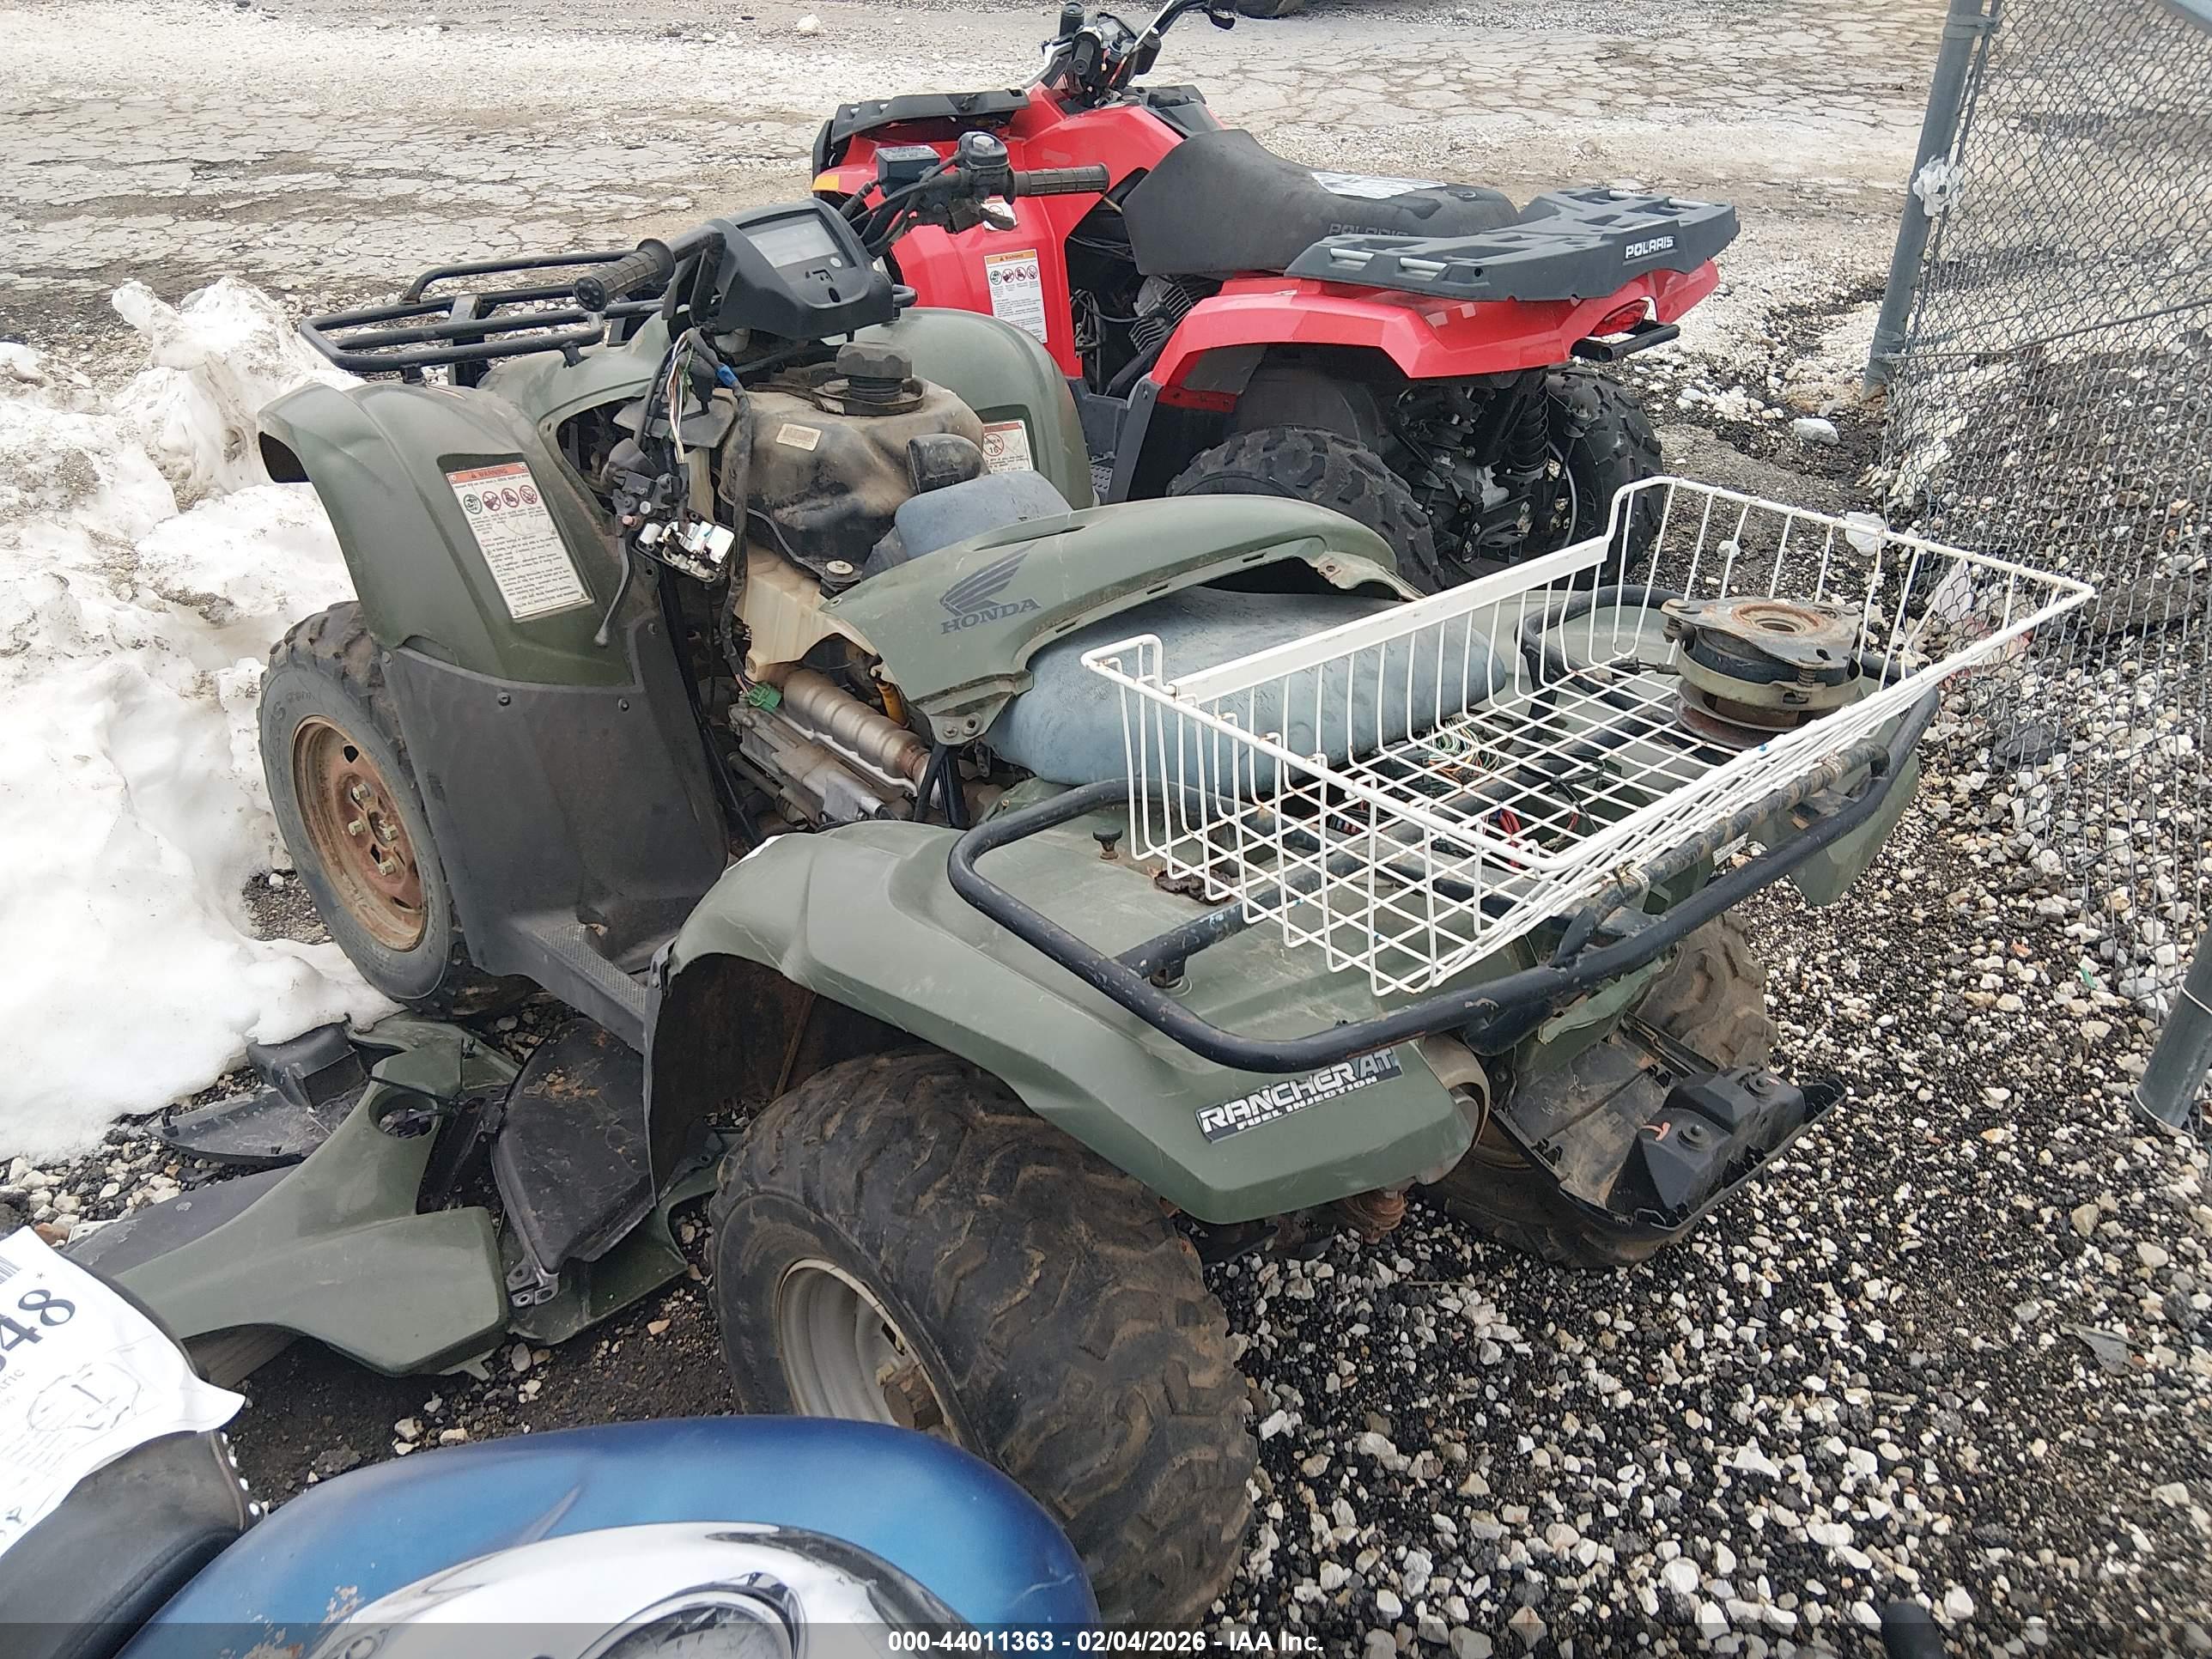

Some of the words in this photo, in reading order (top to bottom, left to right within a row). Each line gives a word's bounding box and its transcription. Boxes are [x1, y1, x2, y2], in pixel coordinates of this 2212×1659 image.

[1626, 236, 1674, 258] POLARIS
[941, 598, 1042, 635] HONDA
[1200, 1061, 1357, 1133] RANCHER
[1359, 1047, 1395, 1079] AT
[1237, 1107, 1283, 1131] FUEL
[1285, 1076, 1378, 1114] INJECTION
[0, 1289, 76, 1372] 48
